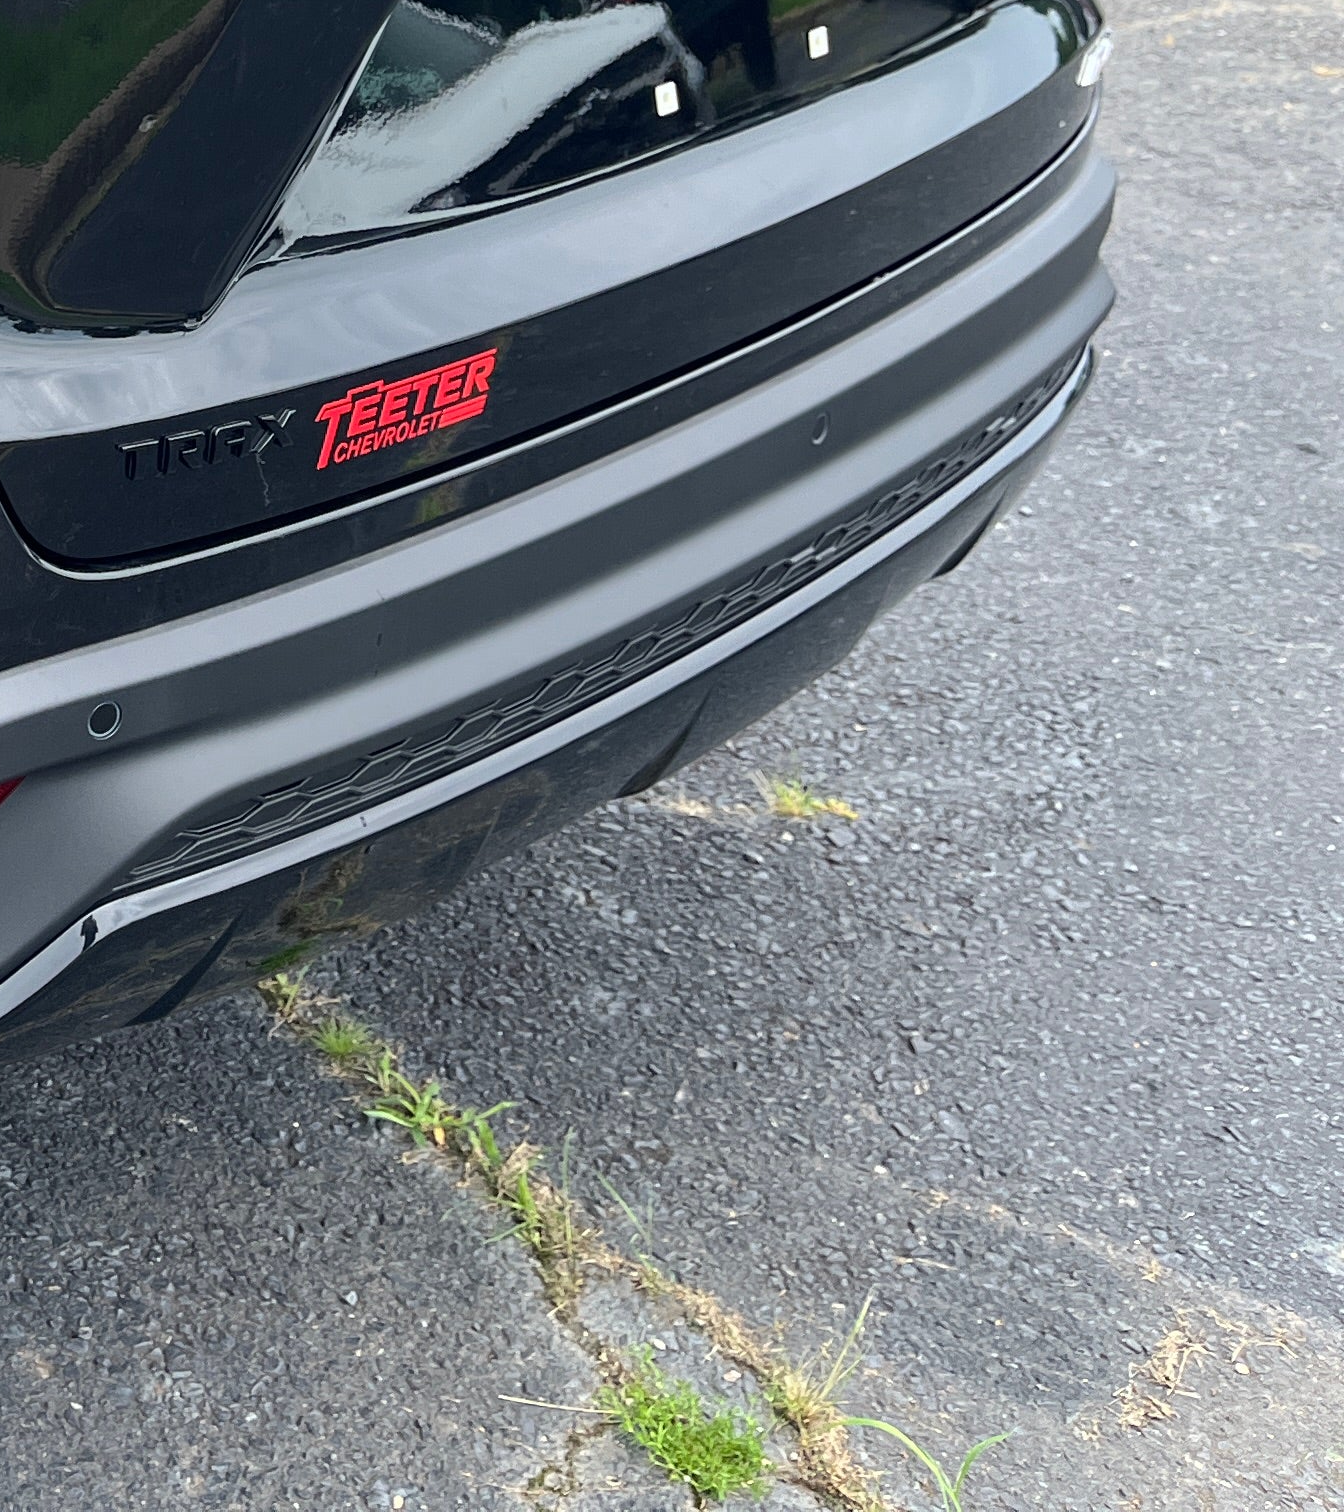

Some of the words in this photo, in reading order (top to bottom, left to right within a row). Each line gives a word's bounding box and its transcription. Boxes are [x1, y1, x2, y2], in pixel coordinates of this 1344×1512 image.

[115, 409, 297, 480] TRAX
[316, 352, 496, 470] TEETER
[333, 410, 443, 465] CHEVROLET
